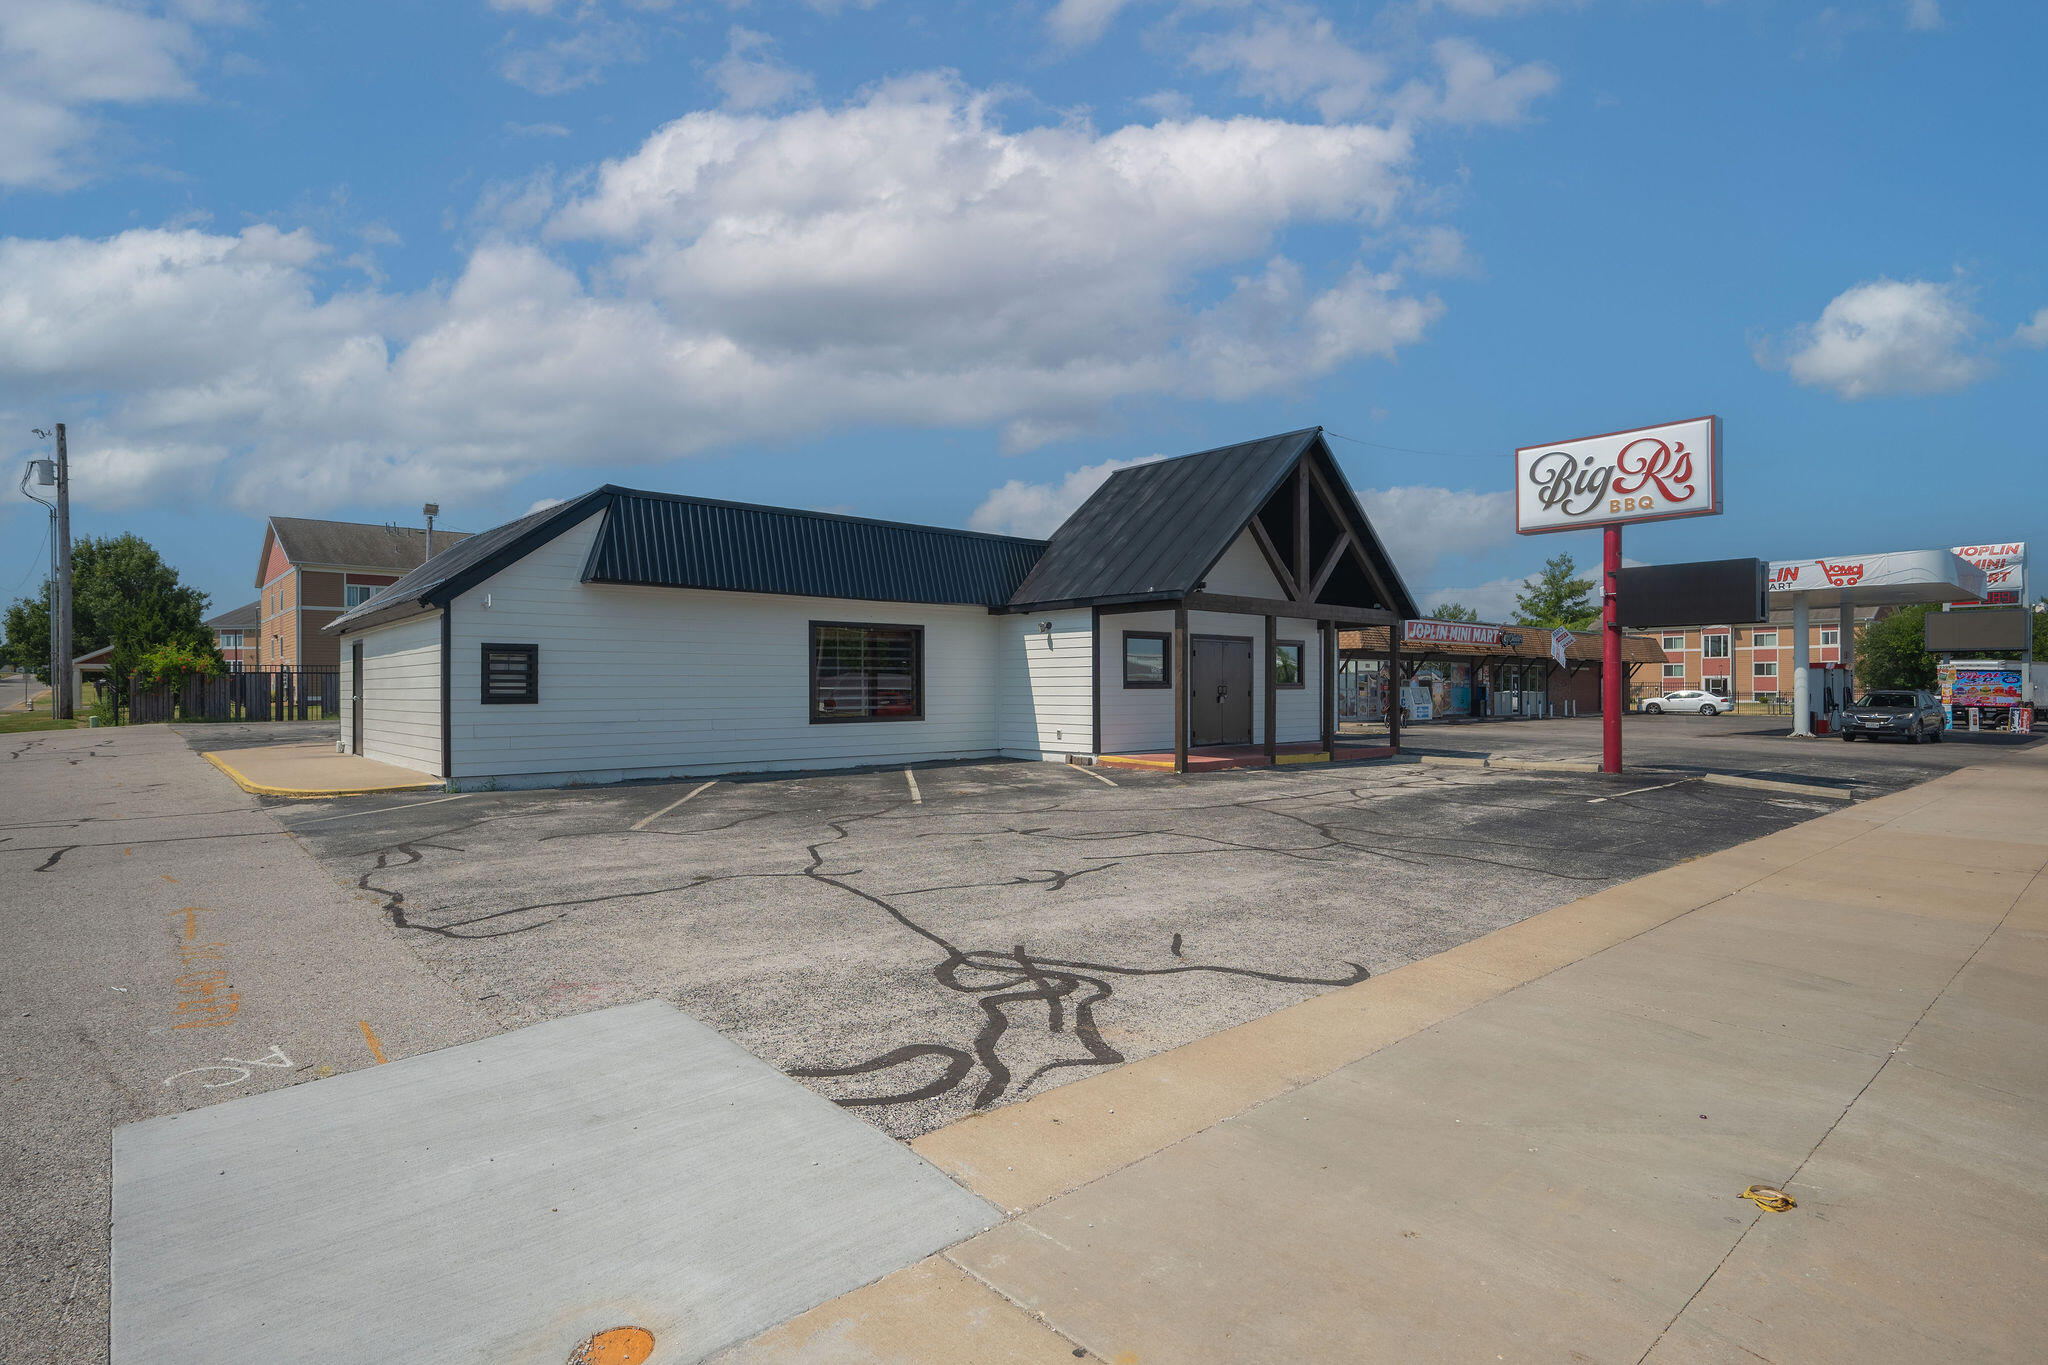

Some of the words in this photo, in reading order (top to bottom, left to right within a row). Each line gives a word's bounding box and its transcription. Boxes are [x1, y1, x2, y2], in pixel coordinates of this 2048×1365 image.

[1529, 451, 1615, 516] Big
[1612, 437, 1695, 503] R's
[1609, 495, 1655, 513] BBQ
[1957, 544, 2020, 557] JOPLIN
[1987, 571, 2012, 583] RT
[1769, 582, 1793, 590] ART
[1409, 623, 1449, 641] JOPLIN
[1449, 625, 1471, 642] MINI
[1472, 627, 1500, 644] MART
